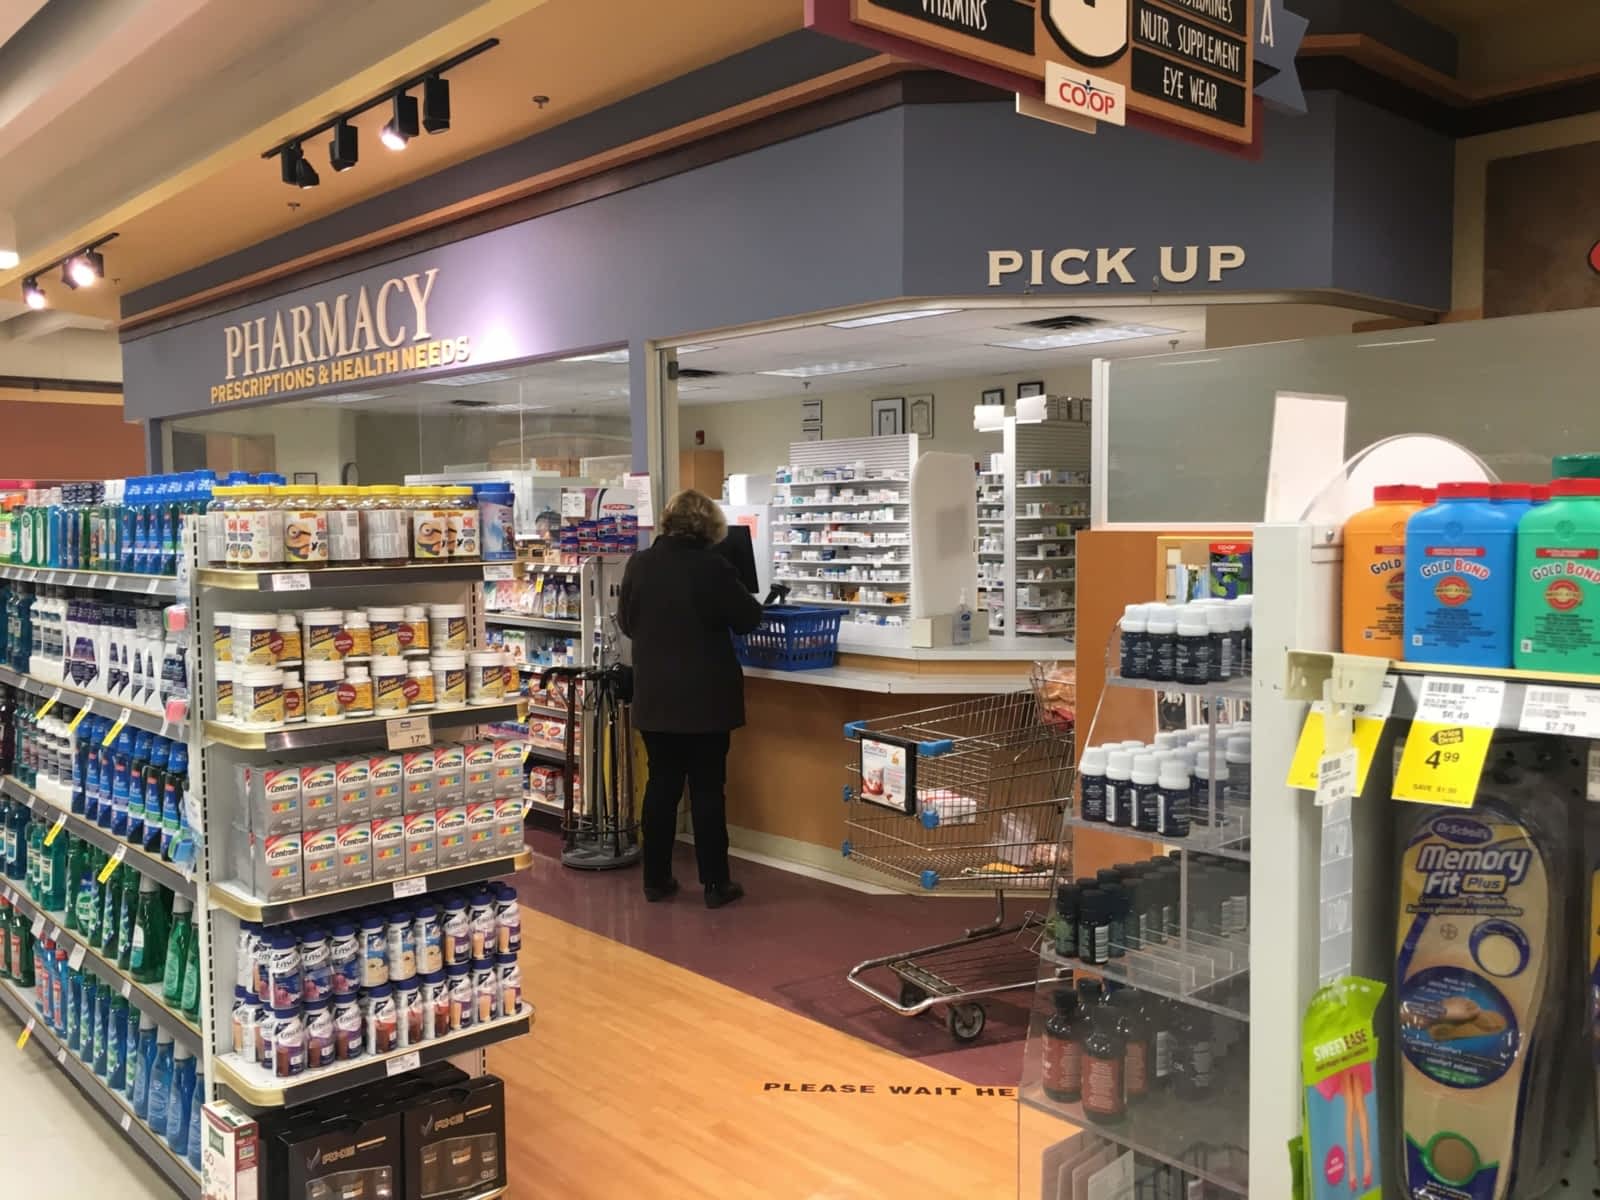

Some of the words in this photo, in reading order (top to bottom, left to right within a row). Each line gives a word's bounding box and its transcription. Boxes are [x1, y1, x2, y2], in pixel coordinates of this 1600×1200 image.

[1139, 8, 1172, 48] NUTR.
[1177, 23, 1241, 73] SUPPLEMENT
[1163, 66, 1184, 99] EYE
[1188, 74, 1218, 111] WEAR
[987, 245, 1138, 287] PICK
[1158, 244, 1247, 284] UP
[223, 267, 440, 381] PHARMACY
[210, 367, 316, 405] PRESCRIPTIONS
[318, 366, 330, 385] &
[331, 350, 401, 384] HEALTH
[401, 335, 470, 372] NEEDS
[1370, 557, 1402, 575] GOLD
[1421, 560, 1452, 577] GOLD
[1454, 557, 1491, 580] BOND
[1531, 562, 1563, 582] GOLD
[1565, 560, 1600, 584] BOND
[498, 751, 522, 760] Centrum
[438, 760, 462, 769] Centrum
[374, 770, 400, 779] Centrum
[408, 766, 433, 775] Centrum
[307, 780, 334, 789] Centrum
[342, 775, 368, 784] Centrum
[270, 784, 298, 793] Centrum
[440, 820, 465, 829] Centrum
[409, 825, 435, 835] Centrum
[377, 831, 403, 841] Centrum
[342, 837, 370, 847] Centrum
[308, 843, 336, 853] Centrum
[270, 848, 299, 859] Centrum
[1417, 844, 1529, 883] Memory
[1424, 870, 1461, 895] Fit
[1466, 877, 1501, 889] Plus
[763, 1083, 876, 1094] PLEASE
[889, 1085, 963, 1097] WAIT
